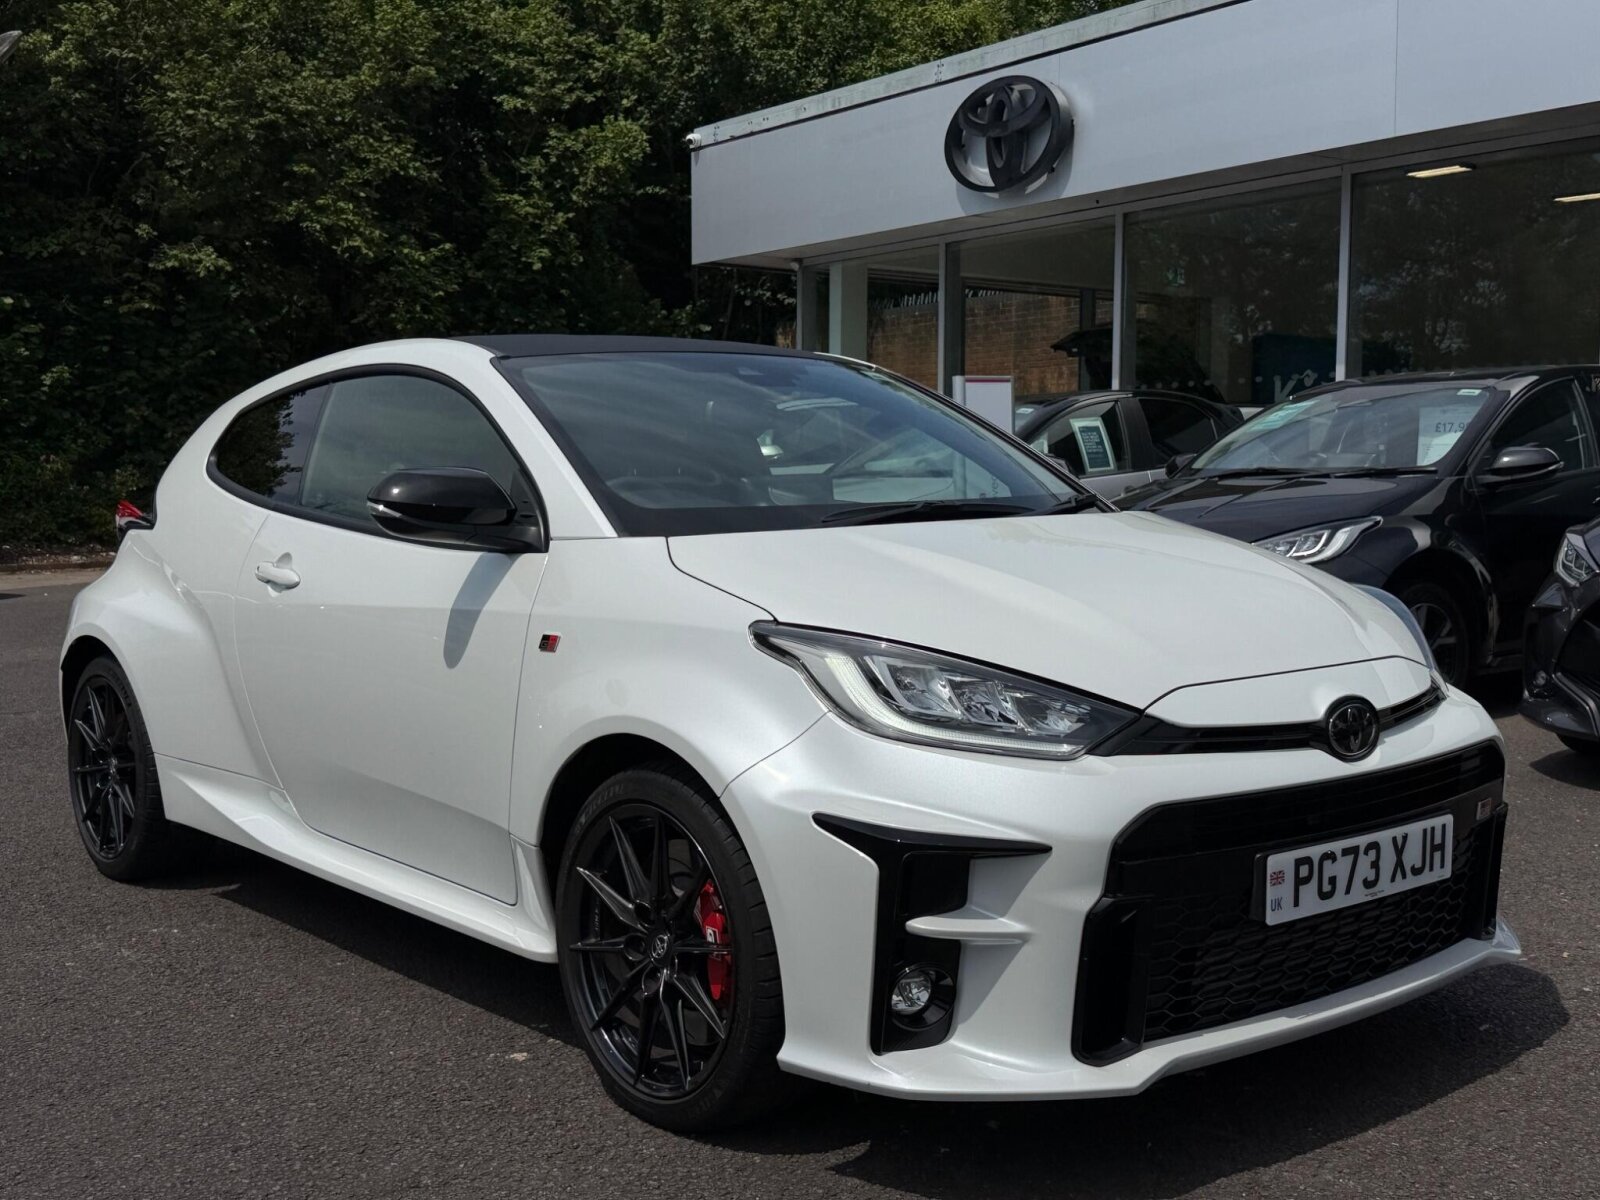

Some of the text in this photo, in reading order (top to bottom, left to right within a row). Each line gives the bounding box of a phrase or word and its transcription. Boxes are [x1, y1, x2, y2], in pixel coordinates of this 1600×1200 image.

[1435, 422, 1468, 433] £17,9
[1293, 823, 1446, 908] PG73 XJH
[1270, 897, 1283, 912] UK
